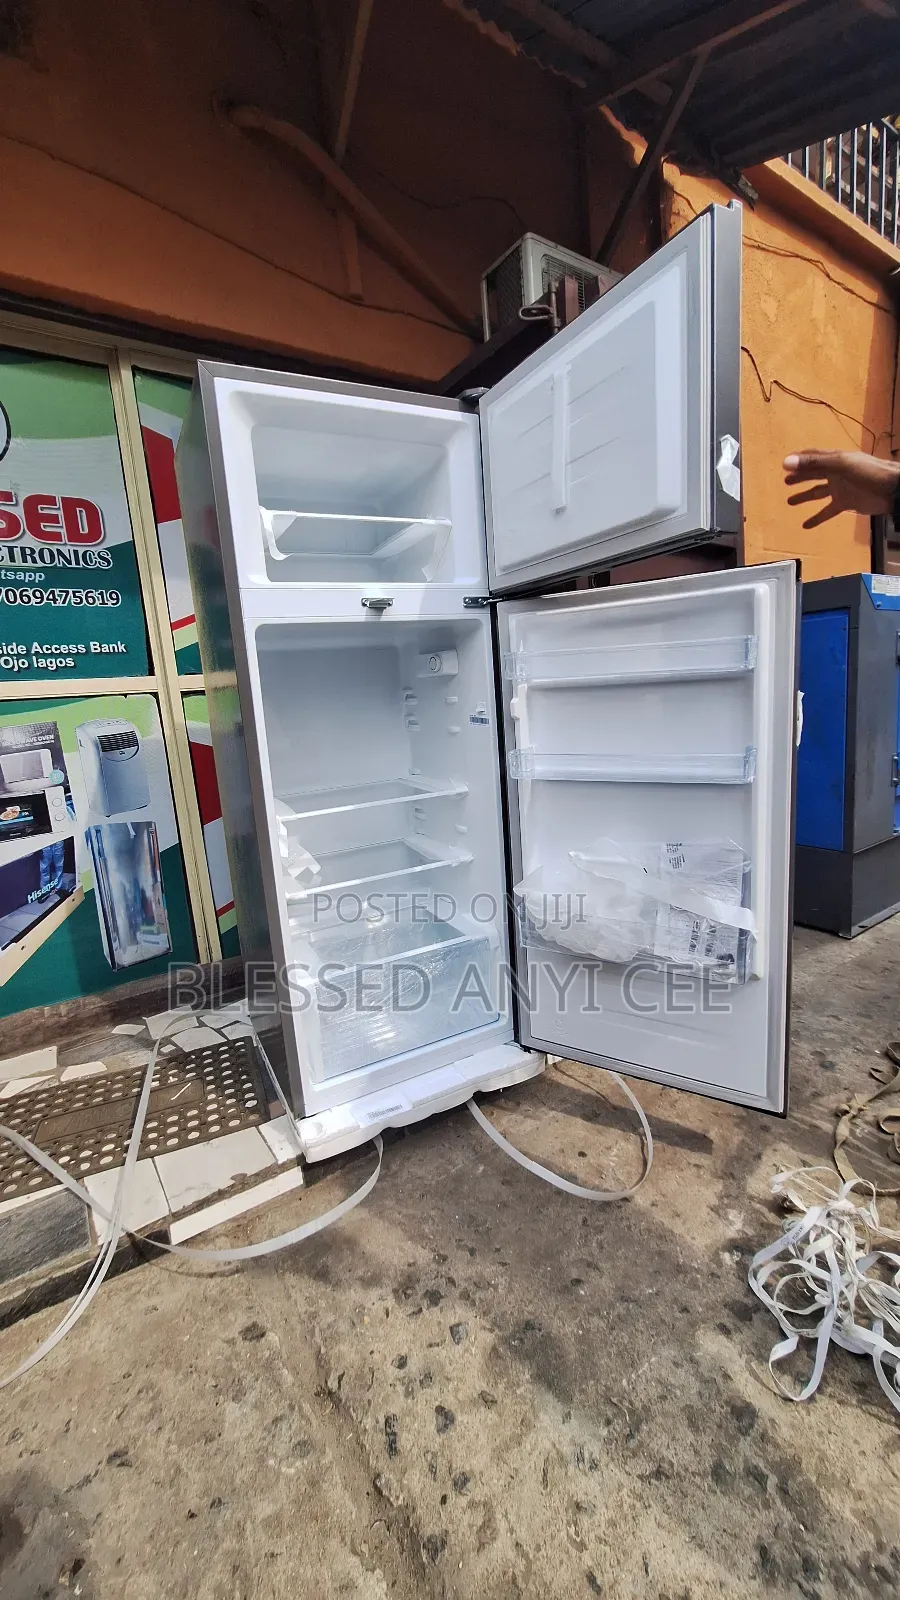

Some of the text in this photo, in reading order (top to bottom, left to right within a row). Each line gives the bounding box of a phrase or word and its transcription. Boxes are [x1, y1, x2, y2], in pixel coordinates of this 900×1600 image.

[0, 545, 113, 568] TRONICS
[0, 569, 45, 582] tsapp
[0, 587, 121, 607] 069475619
[0, 641, 127, 654] ide Access Bank
[0, 656, 75, 671] Ojo lagos
[27, 878, 59, 904] Hisense
